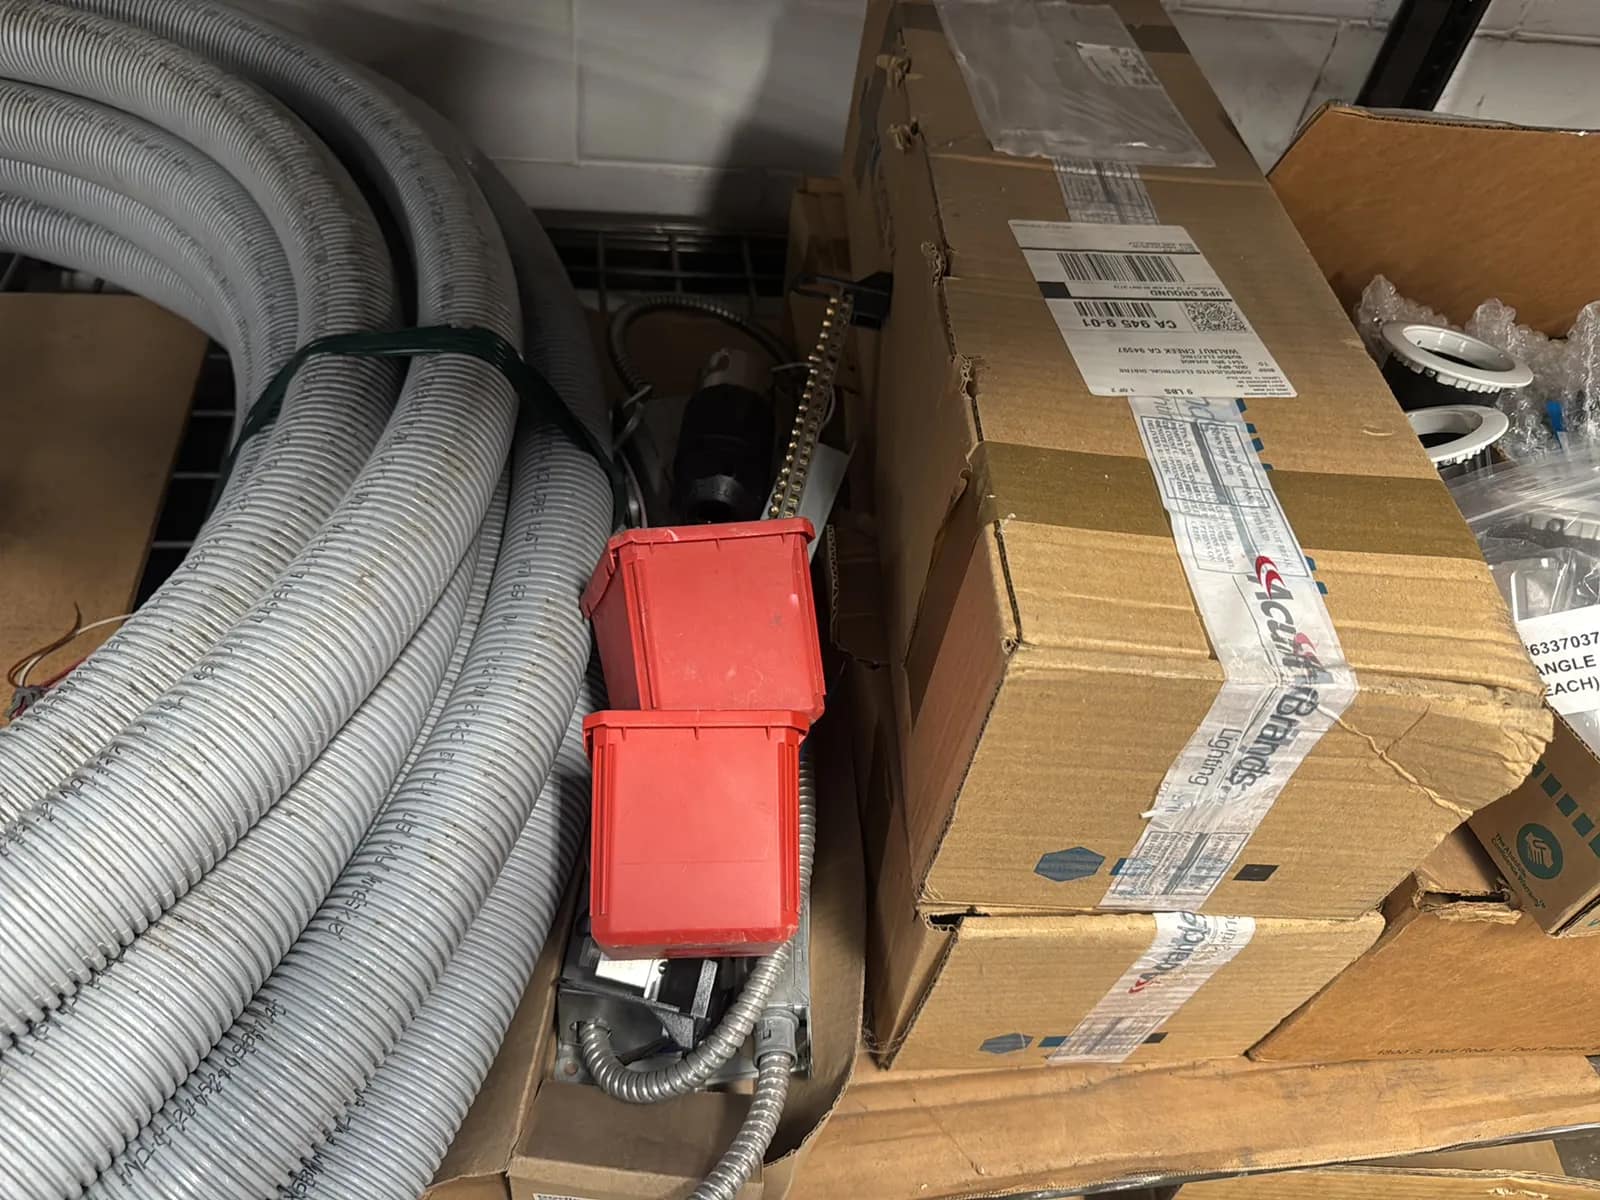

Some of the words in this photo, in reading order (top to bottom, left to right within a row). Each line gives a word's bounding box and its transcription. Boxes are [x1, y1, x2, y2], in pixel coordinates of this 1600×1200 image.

[1149, 289, 1197, 297] GROUND
[1081, 318, 1117, 328] 9-01
[1121, 319, 1150, 329] 945
[1155, 320, 1177, 329] CA
[1525, 631, 1599, 656] 6337037
[1188, 728, 1243, 787] Lighting
